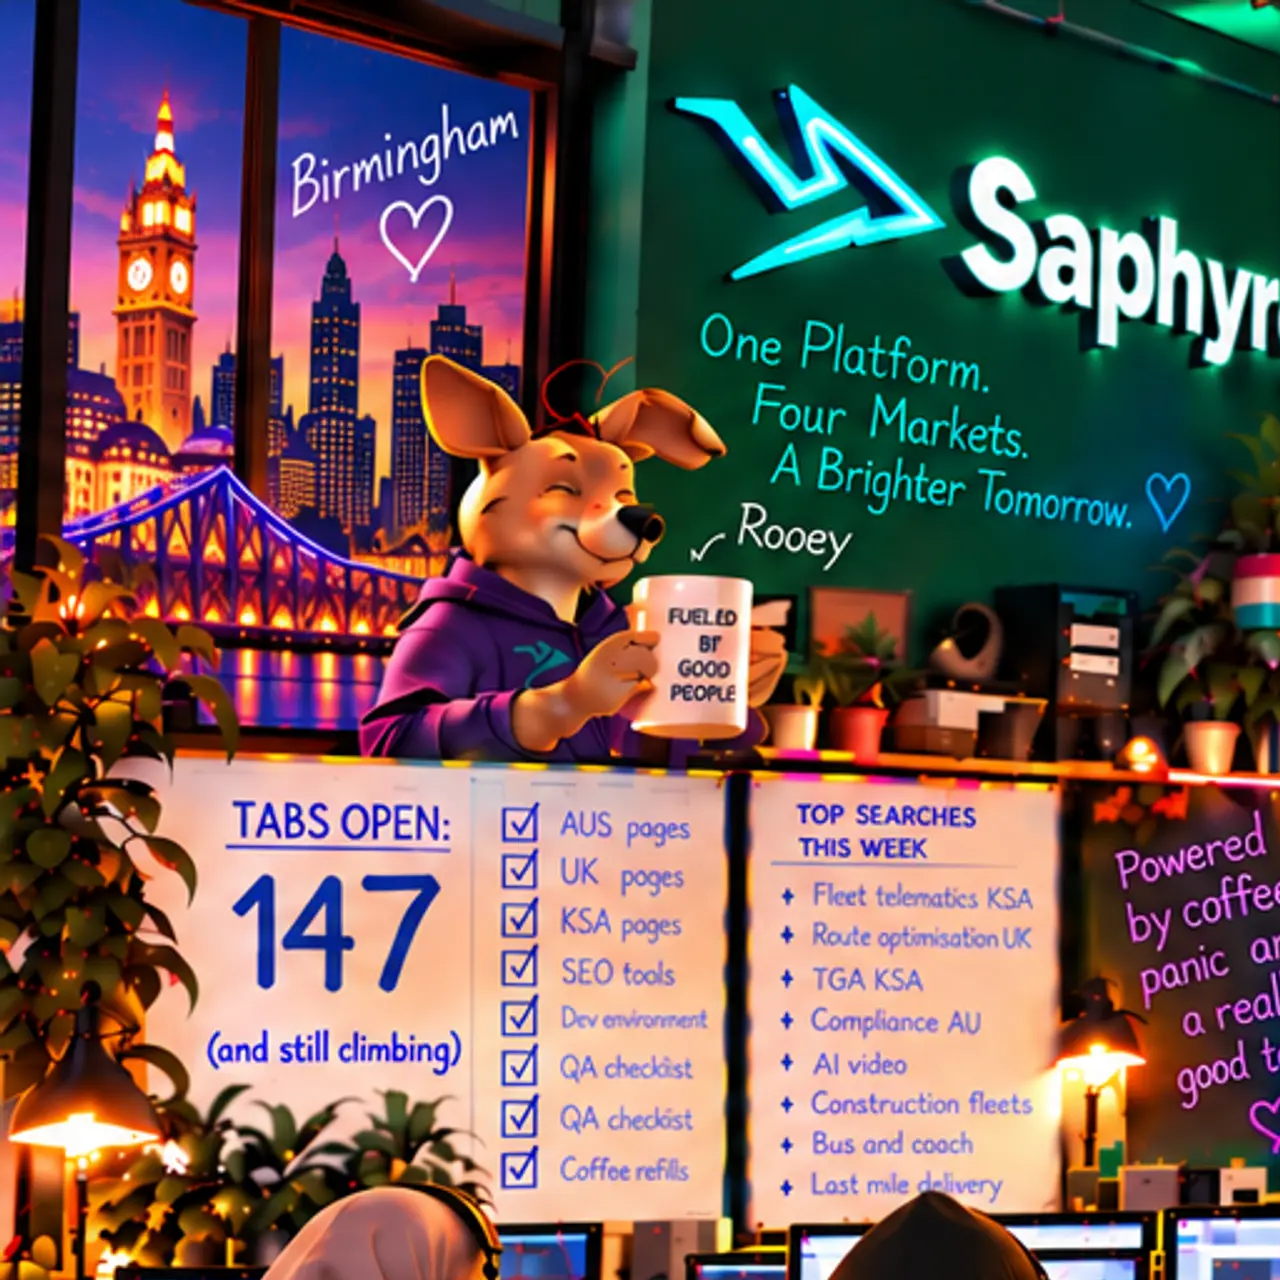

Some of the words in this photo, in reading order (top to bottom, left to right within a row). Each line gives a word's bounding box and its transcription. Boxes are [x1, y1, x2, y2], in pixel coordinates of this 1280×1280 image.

[291, 104, 519, 218] Birmingham
[701, 313, 781, 365] One
[802, 320, 988, 392] Platform.
[753, 383, 846, 434] Four
[870, 394, 1027, 458] Markets.
[771, 443, 800, 485] A
[818, 447, 965, 514] Brighter
[978, 469, 1131, 528] Tomorrow.
[738, 503, 851, 570] Rooey
[678, 659, 731, 678] GOOD
[233, 801, 329, 838] TABS
[341, 804, 449, 840] OPEN:
[560, 811, 612, 837] AUS
[797, 804, 844, 824] TOP
[857, 804, 976, 828] SEARCHES
[799, 838, 851, 857] THIS
[860, 838, 927, 858] WEEK
[1115, 811, 1266, 888] Powered
[232, 875, 440, 992] 147
[1127, 903, 1171, 951] by
[562, 958, 613, 985] SEO
[813, 967, 866, 991] TGA
[875, 968, 923, 991] KSA
[1141, 945, 1228, 1008] panic
[1183, 1012, 1205, 1036] a
[208, 1030, 268, 1069] (and
[280, 1030, 328, 1063] still
[339, 1031, 461, 1076] climbing)
[813, 1053, 838, 1075] AI
[848, 1052, 907, 1075] video
[1178, 1040, 1250, 1108] good
[811, 1090, 959, 1114] Construction
[969, 1090, 1033, 1114] fleets
